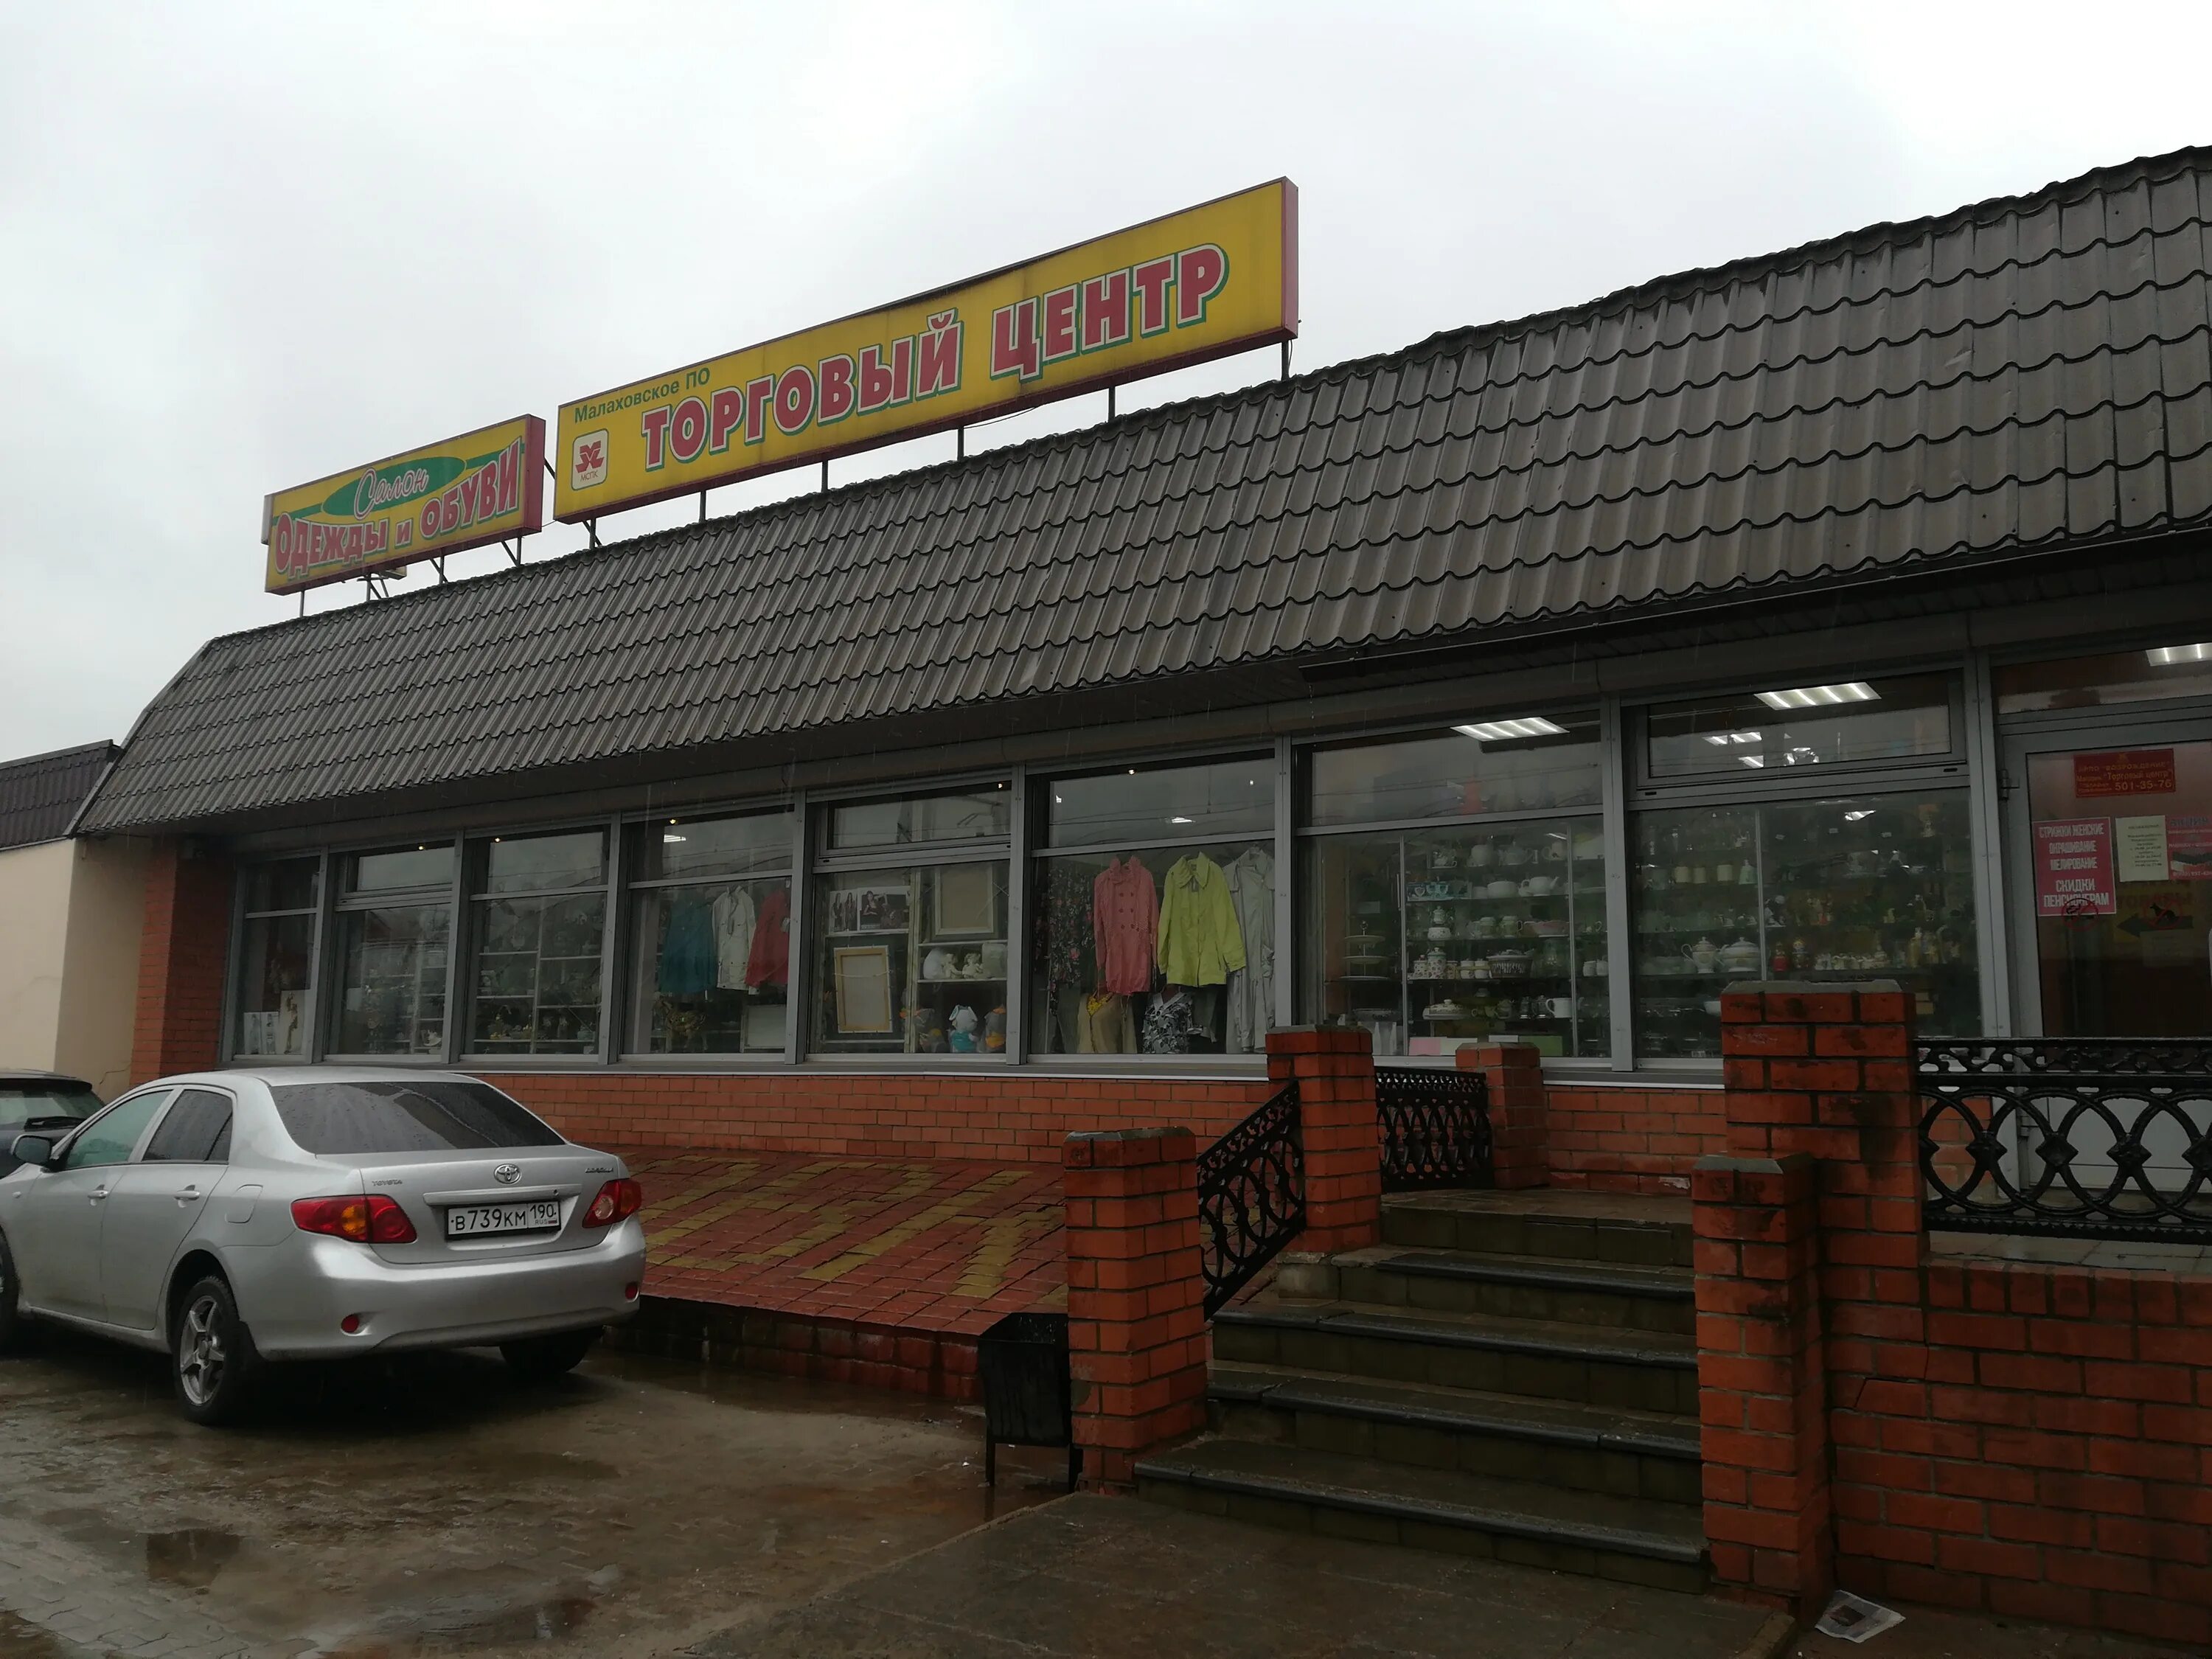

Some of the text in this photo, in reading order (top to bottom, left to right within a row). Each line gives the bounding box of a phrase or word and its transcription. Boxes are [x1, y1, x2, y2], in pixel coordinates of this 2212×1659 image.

[641, 243, 1229, 471] ТОРГОВЫЙ ЦЕНТР
[574, 367, 711, 424] Малаховское ПО
[580, 470, 599, 482] МСПК
[353, 467, 430, 521] Салон
[275, 436, 523, 578] ОДЕЖДЫ и ОБУВИ
[2039, 823, 2104, 838] СТРИЖКИ ЖЕНСКИЕ
[2049, 841, 2097, 855] ОКРАШИВАНИЕ
[2050, 857, 2098, 871] МЕЛИРОВАНИЕ
[2056, 878, 2096, 892] СКИДКИ
[2043, 893, 2110, 908] ПЕНСИОНЕРАМ
[529, 1203, 554, 1220] 190
